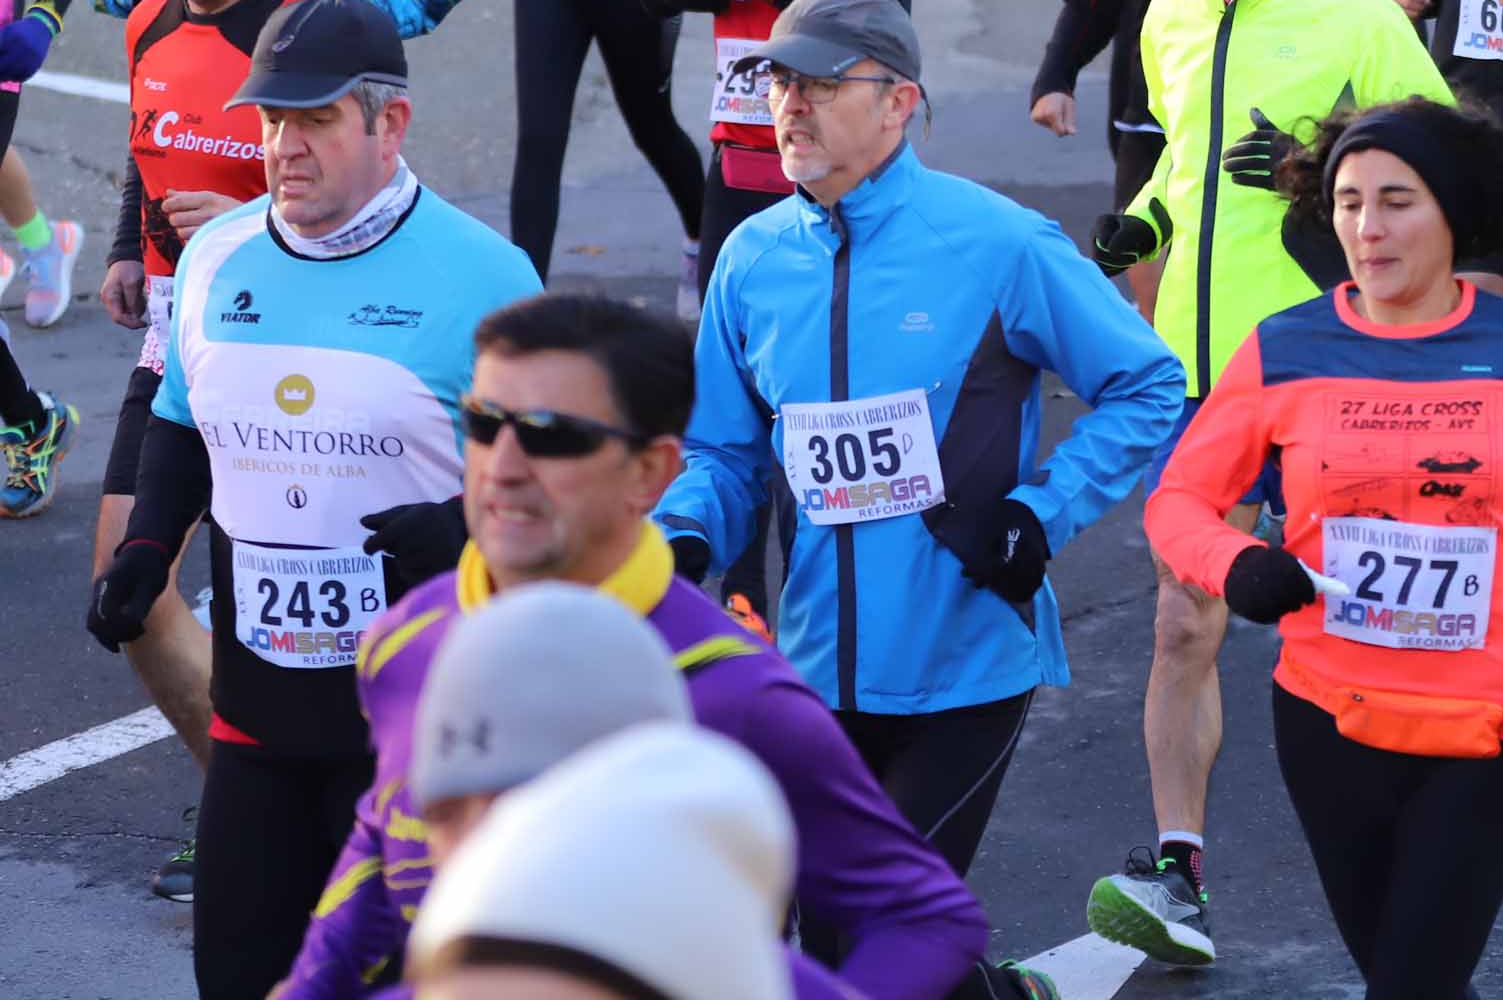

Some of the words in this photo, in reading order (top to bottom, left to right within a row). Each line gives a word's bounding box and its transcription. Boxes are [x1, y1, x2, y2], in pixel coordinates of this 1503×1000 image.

[220, 312, 262, 324] VIATOR
[857, 400, 923, 426] CABRERIZOS
[1341, 400, 1366, 416] 27
[1371, 402, 1413, 417] LIGA
[1421, 400, 1484, 417] CROSS
[808, 427, 902, 485] 305
[301, 463, 321, 477] DE
[325, 463, 368, 479] ALBA
[800, 474, 933, 512] JOMISAGA
[858, 499, 935, 520] REFORMAS
[1387, 530, 1422, 552] CROSS
[276, 558, 309, 575] CROSS
[310, 556, 376, 576] CABRERIZOS
[1355, 551, 1459, 609] 277
[1463, 574, 1480, 597] B
[258, 577, 350, 628] 243
[360, 587, 380, 612] B
[1333, 600, 1477, 637] JOMISAGA
[1397, 636, 1474, 649] REFORMAS
